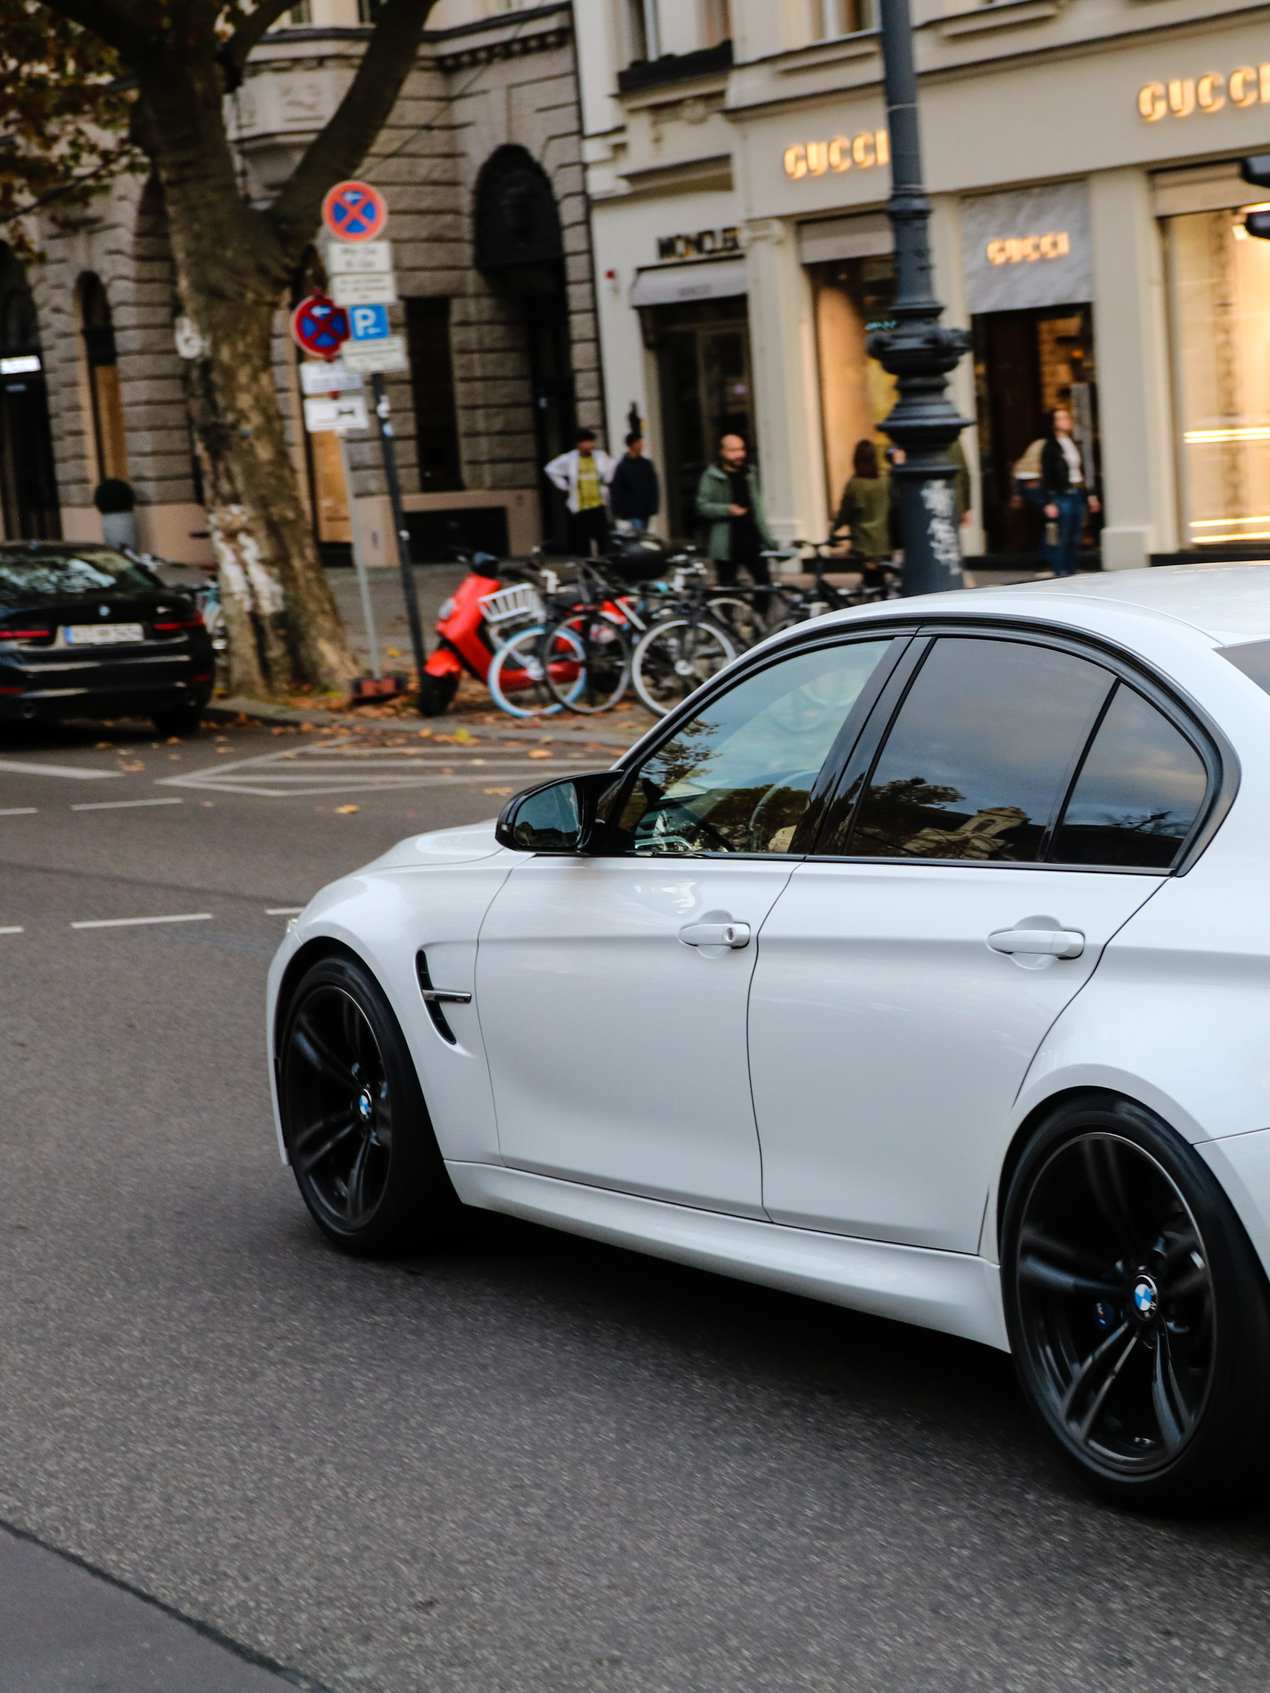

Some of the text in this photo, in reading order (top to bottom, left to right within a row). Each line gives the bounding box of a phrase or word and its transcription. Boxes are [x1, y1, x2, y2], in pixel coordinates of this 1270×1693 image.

[784, 130, 890, 179] GUCCI
[987, 231, 1070, 265] GUCCI
[353, 308, 376, 337] P
